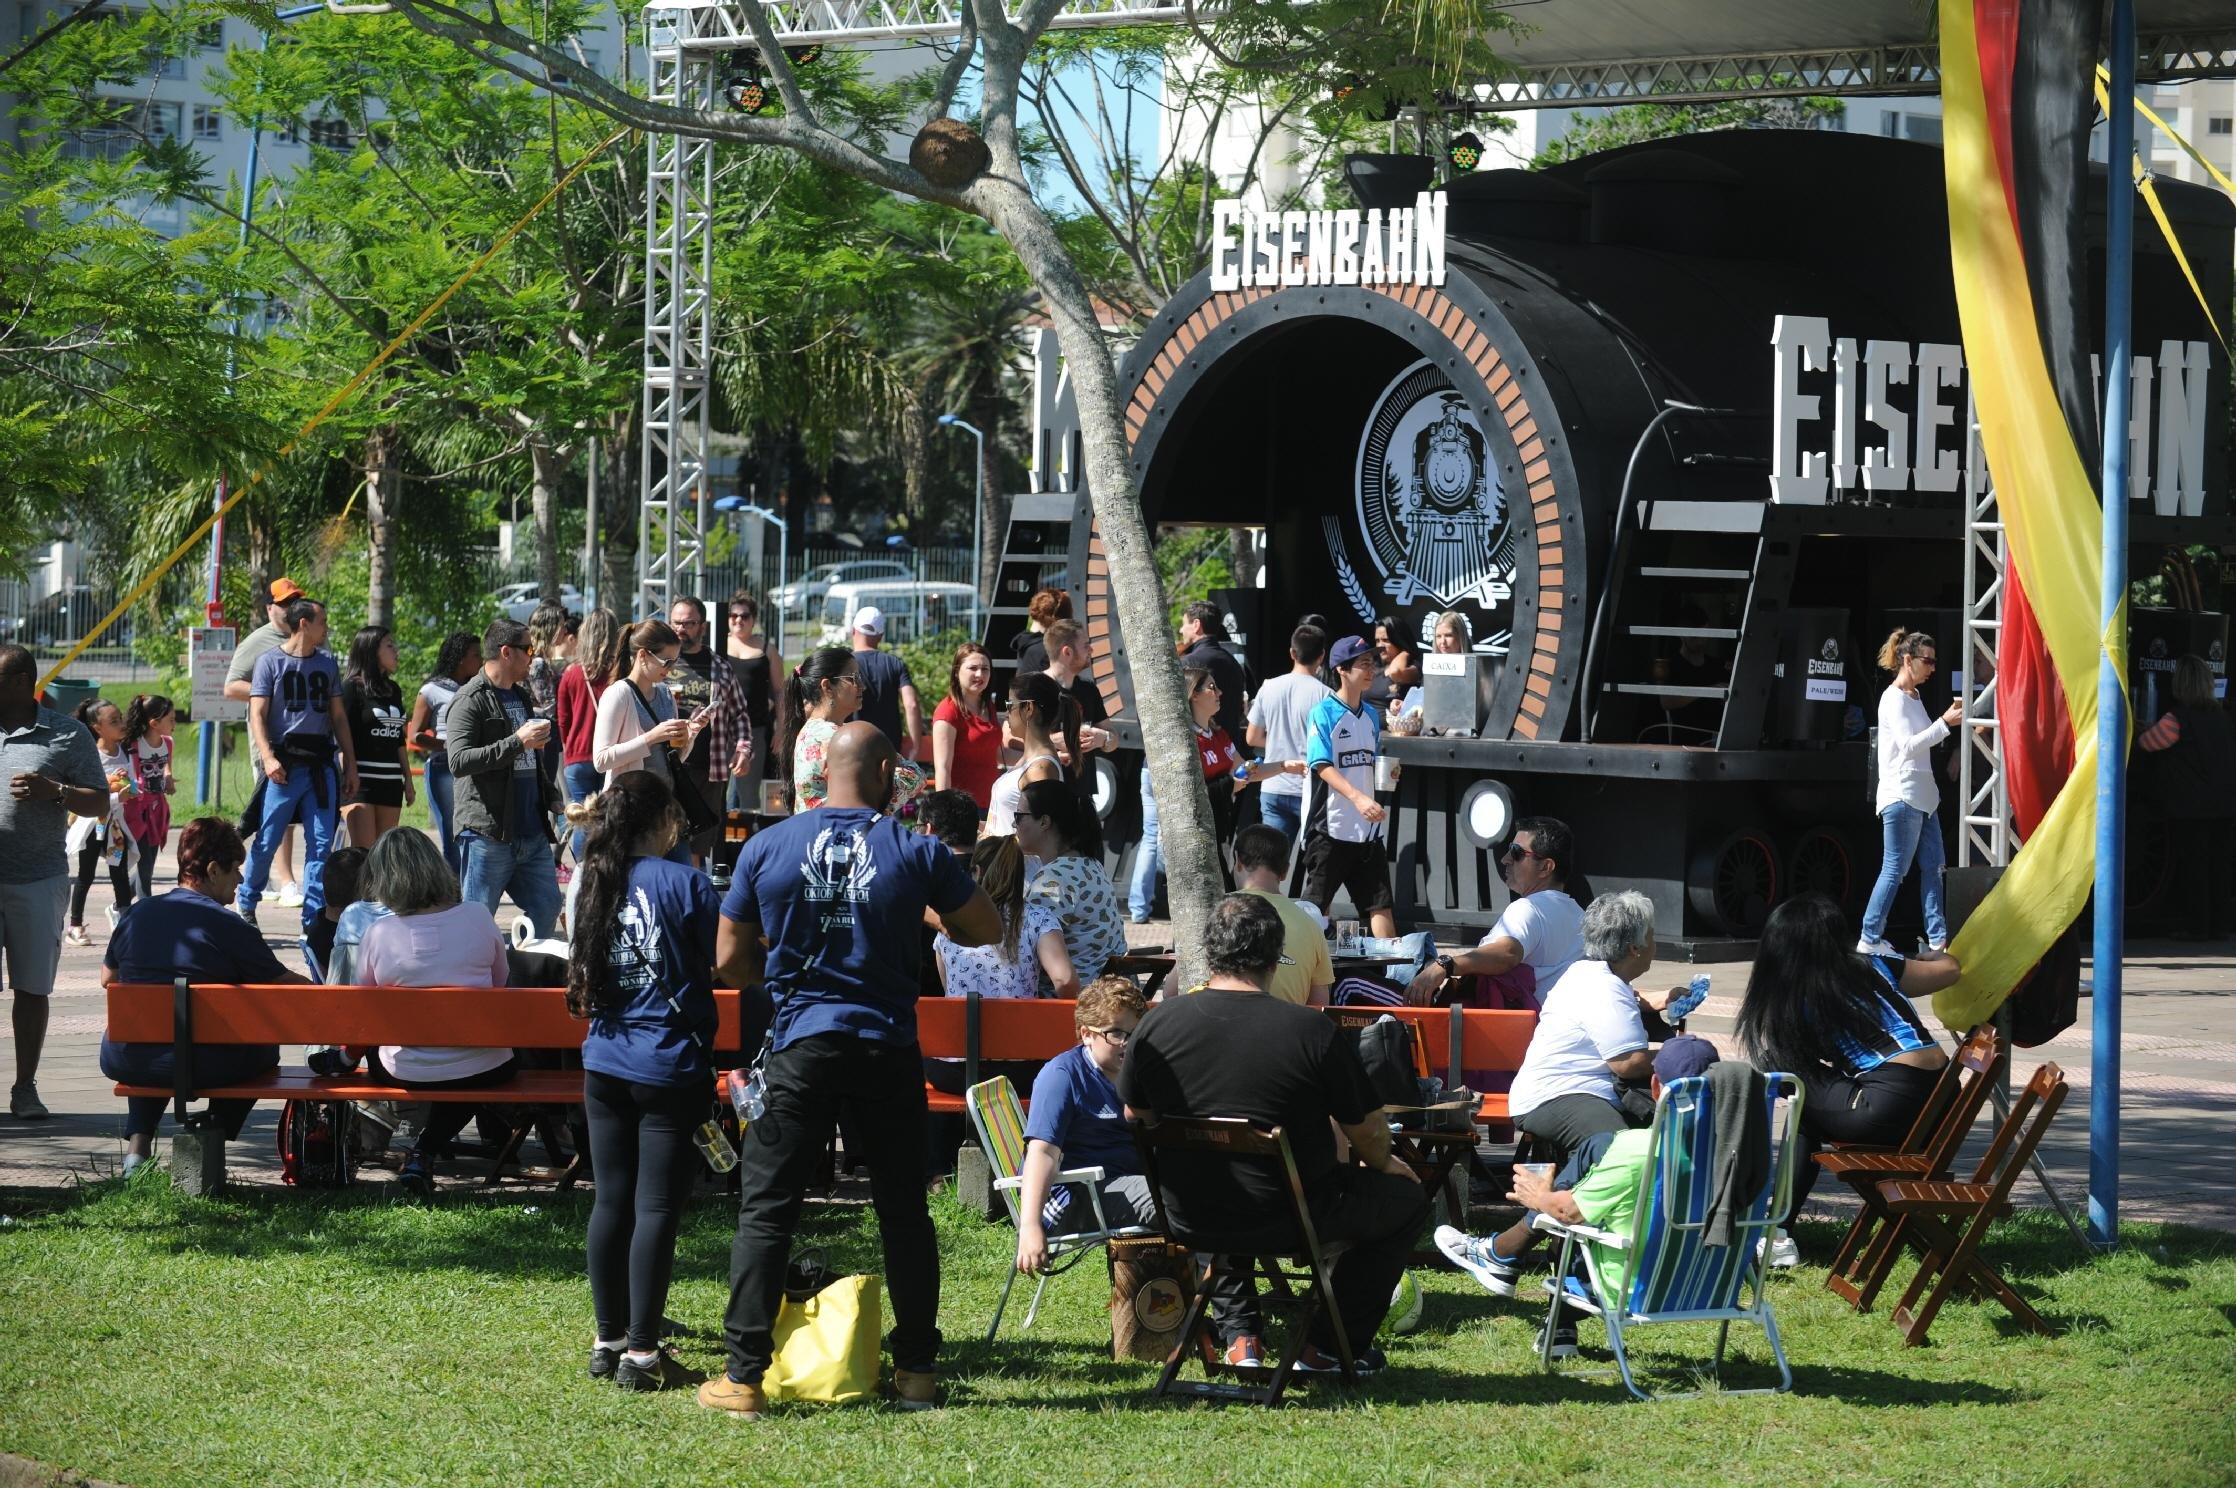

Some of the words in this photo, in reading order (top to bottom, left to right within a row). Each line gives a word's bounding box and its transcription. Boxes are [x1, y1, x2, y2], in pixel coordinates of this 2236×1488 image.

[1210, 191, 1448, 292] EISENBAHN
[1431, 662, 1457, 671] CAIXA
[283, 670, 330, 713] 08
